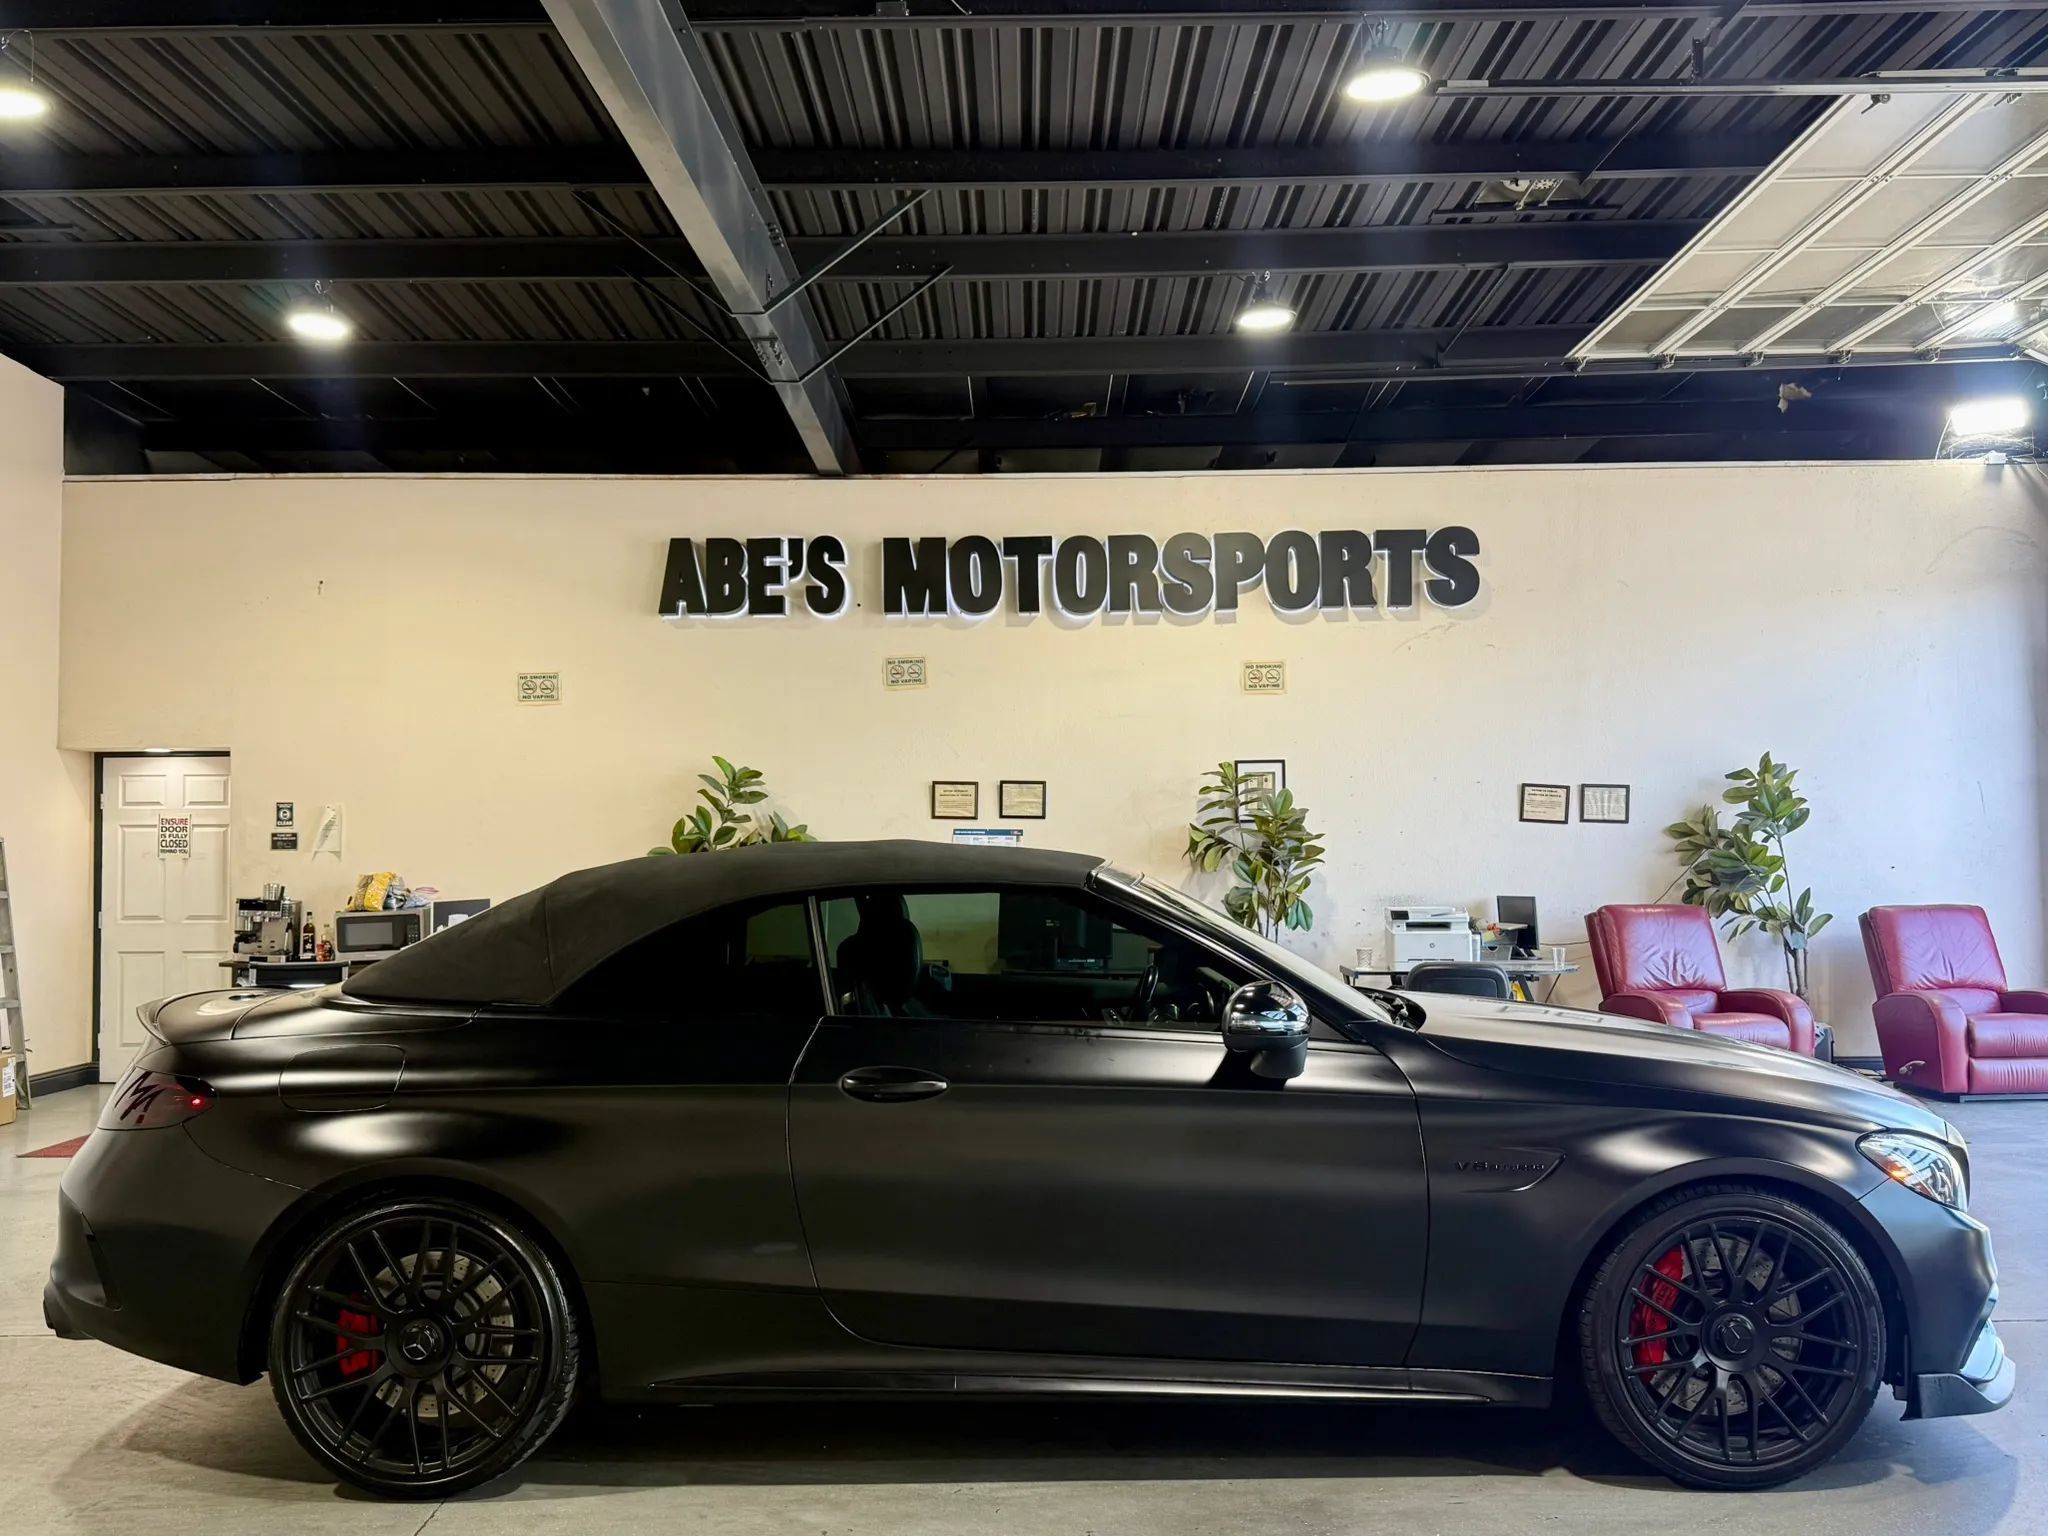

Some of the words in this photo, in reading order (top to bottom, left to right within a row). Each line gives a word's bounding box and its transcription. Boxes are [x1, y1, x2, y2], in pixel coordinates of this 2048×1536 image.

[658, 535, 847, 615] ABE'S
[882, 526, 1480, 615] MOTORSPORTS
[160, 818, 188, 826] ENSURE
[160, 839, 188, 848] CLOSED
